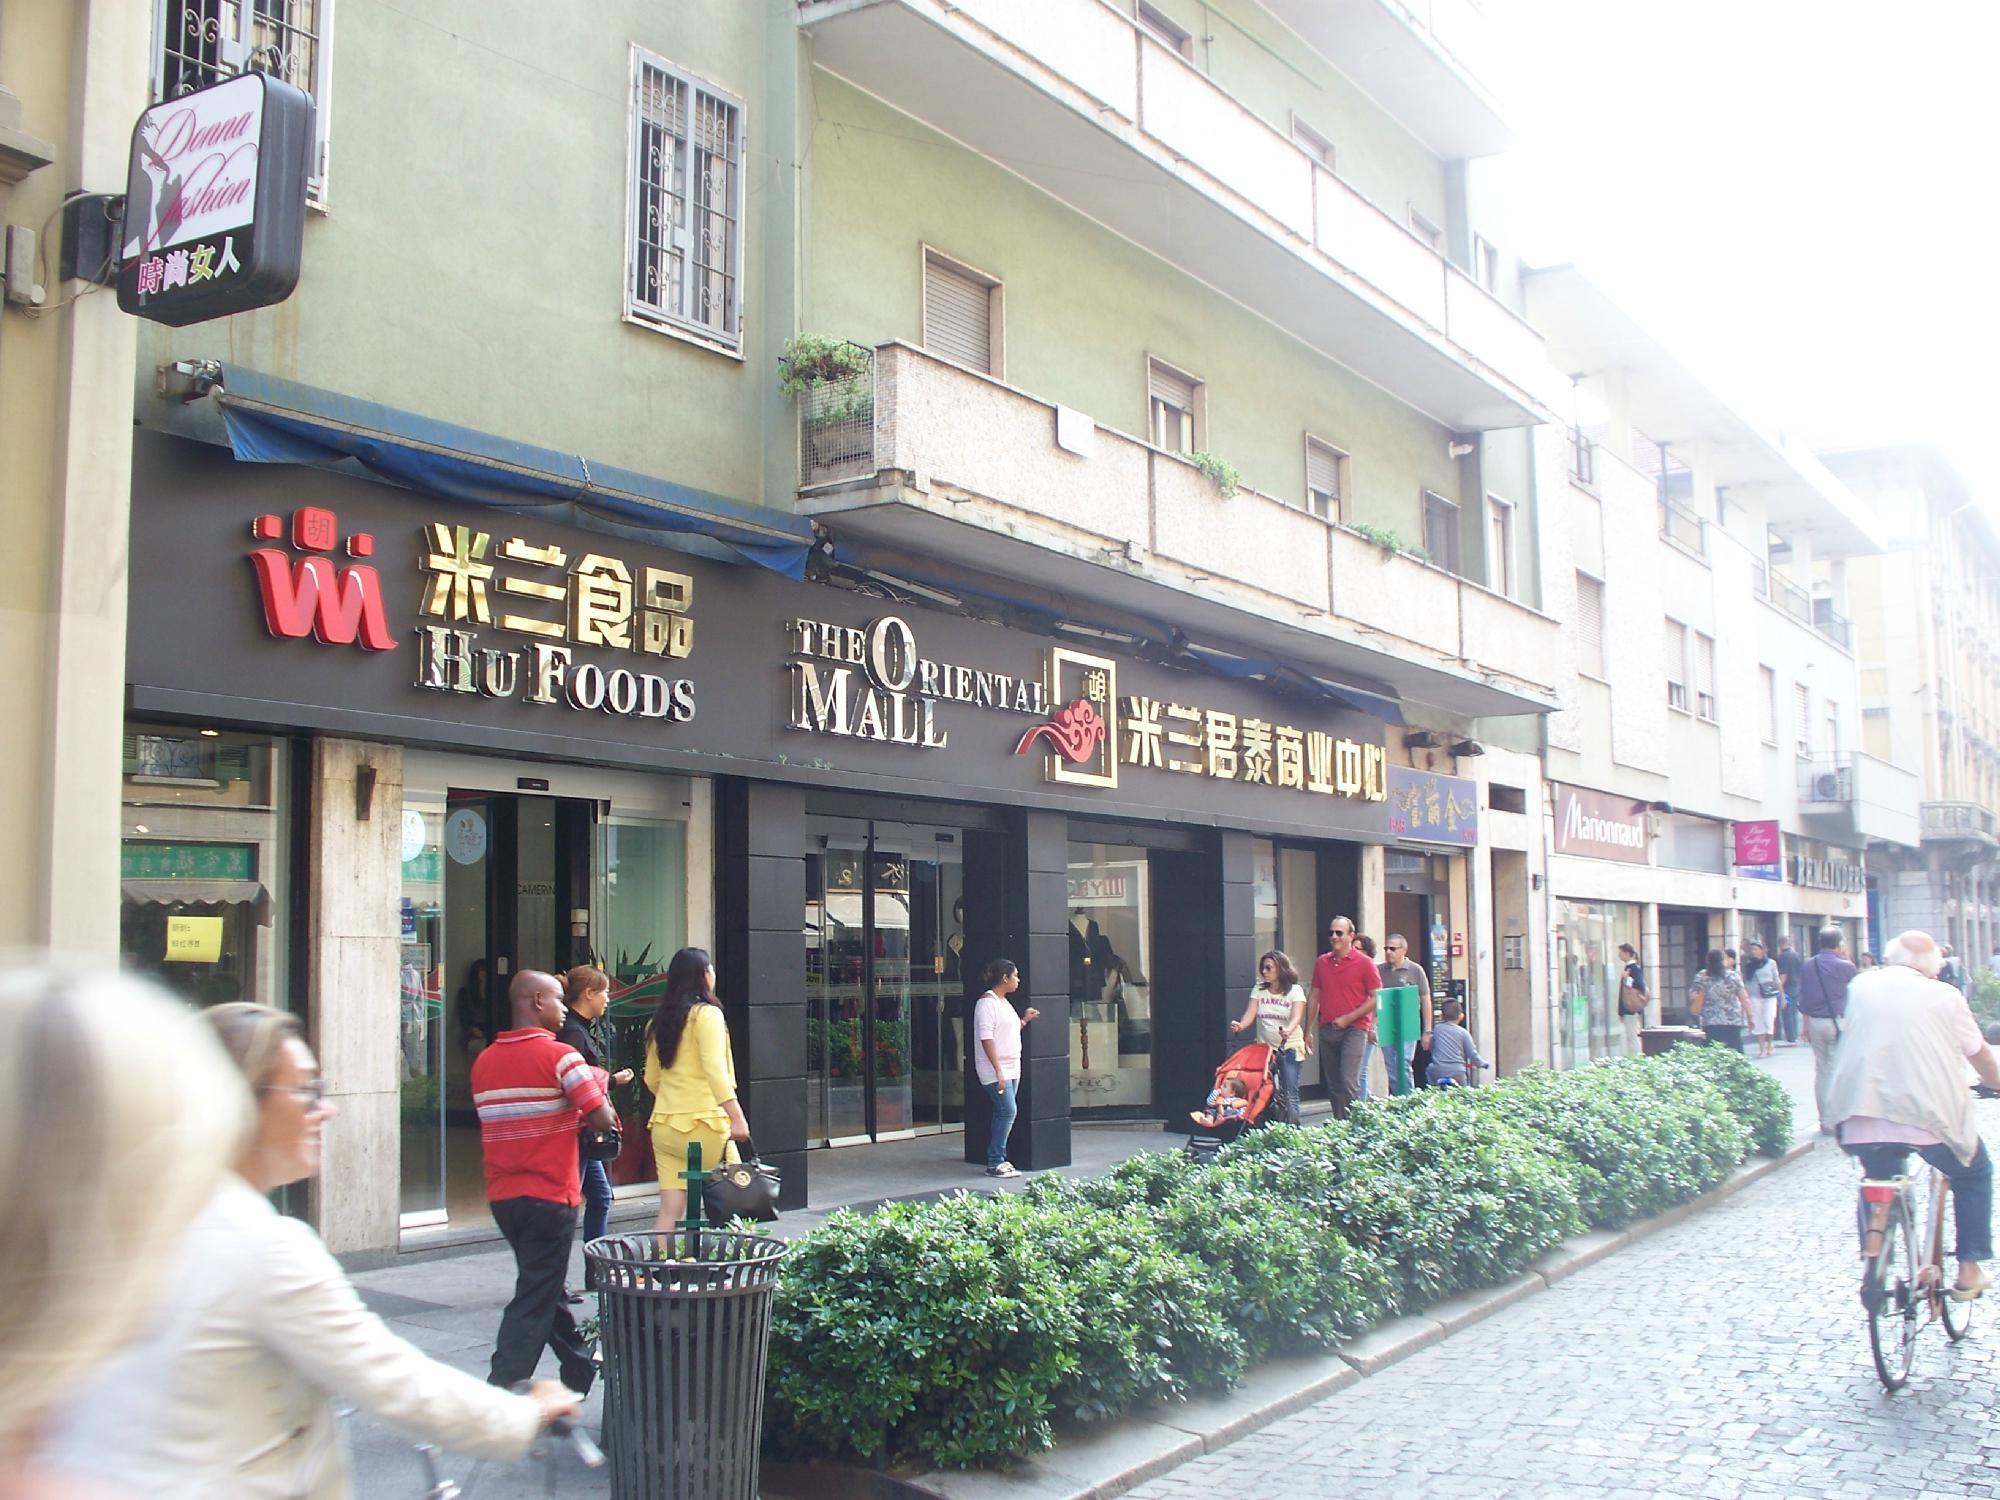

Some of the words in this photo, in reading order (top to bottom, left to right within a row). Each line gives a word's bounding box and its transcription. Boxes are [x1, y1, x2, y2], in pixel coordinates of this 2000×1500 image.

[149, 108, 254, 166] Donna
[137, 236, 241, 295] 時尚女人
[418, 521, 694, 659] 米兰食品
[785, 616, 865, 666] THE
[862, 615, 1050, 717] ORIENTAL
[785, 660, 948, 749] MALL
[1119, 695, 1388, 802] 米兰君泰商业中心
[1562, 793, 1643, 849] Marionnaud
